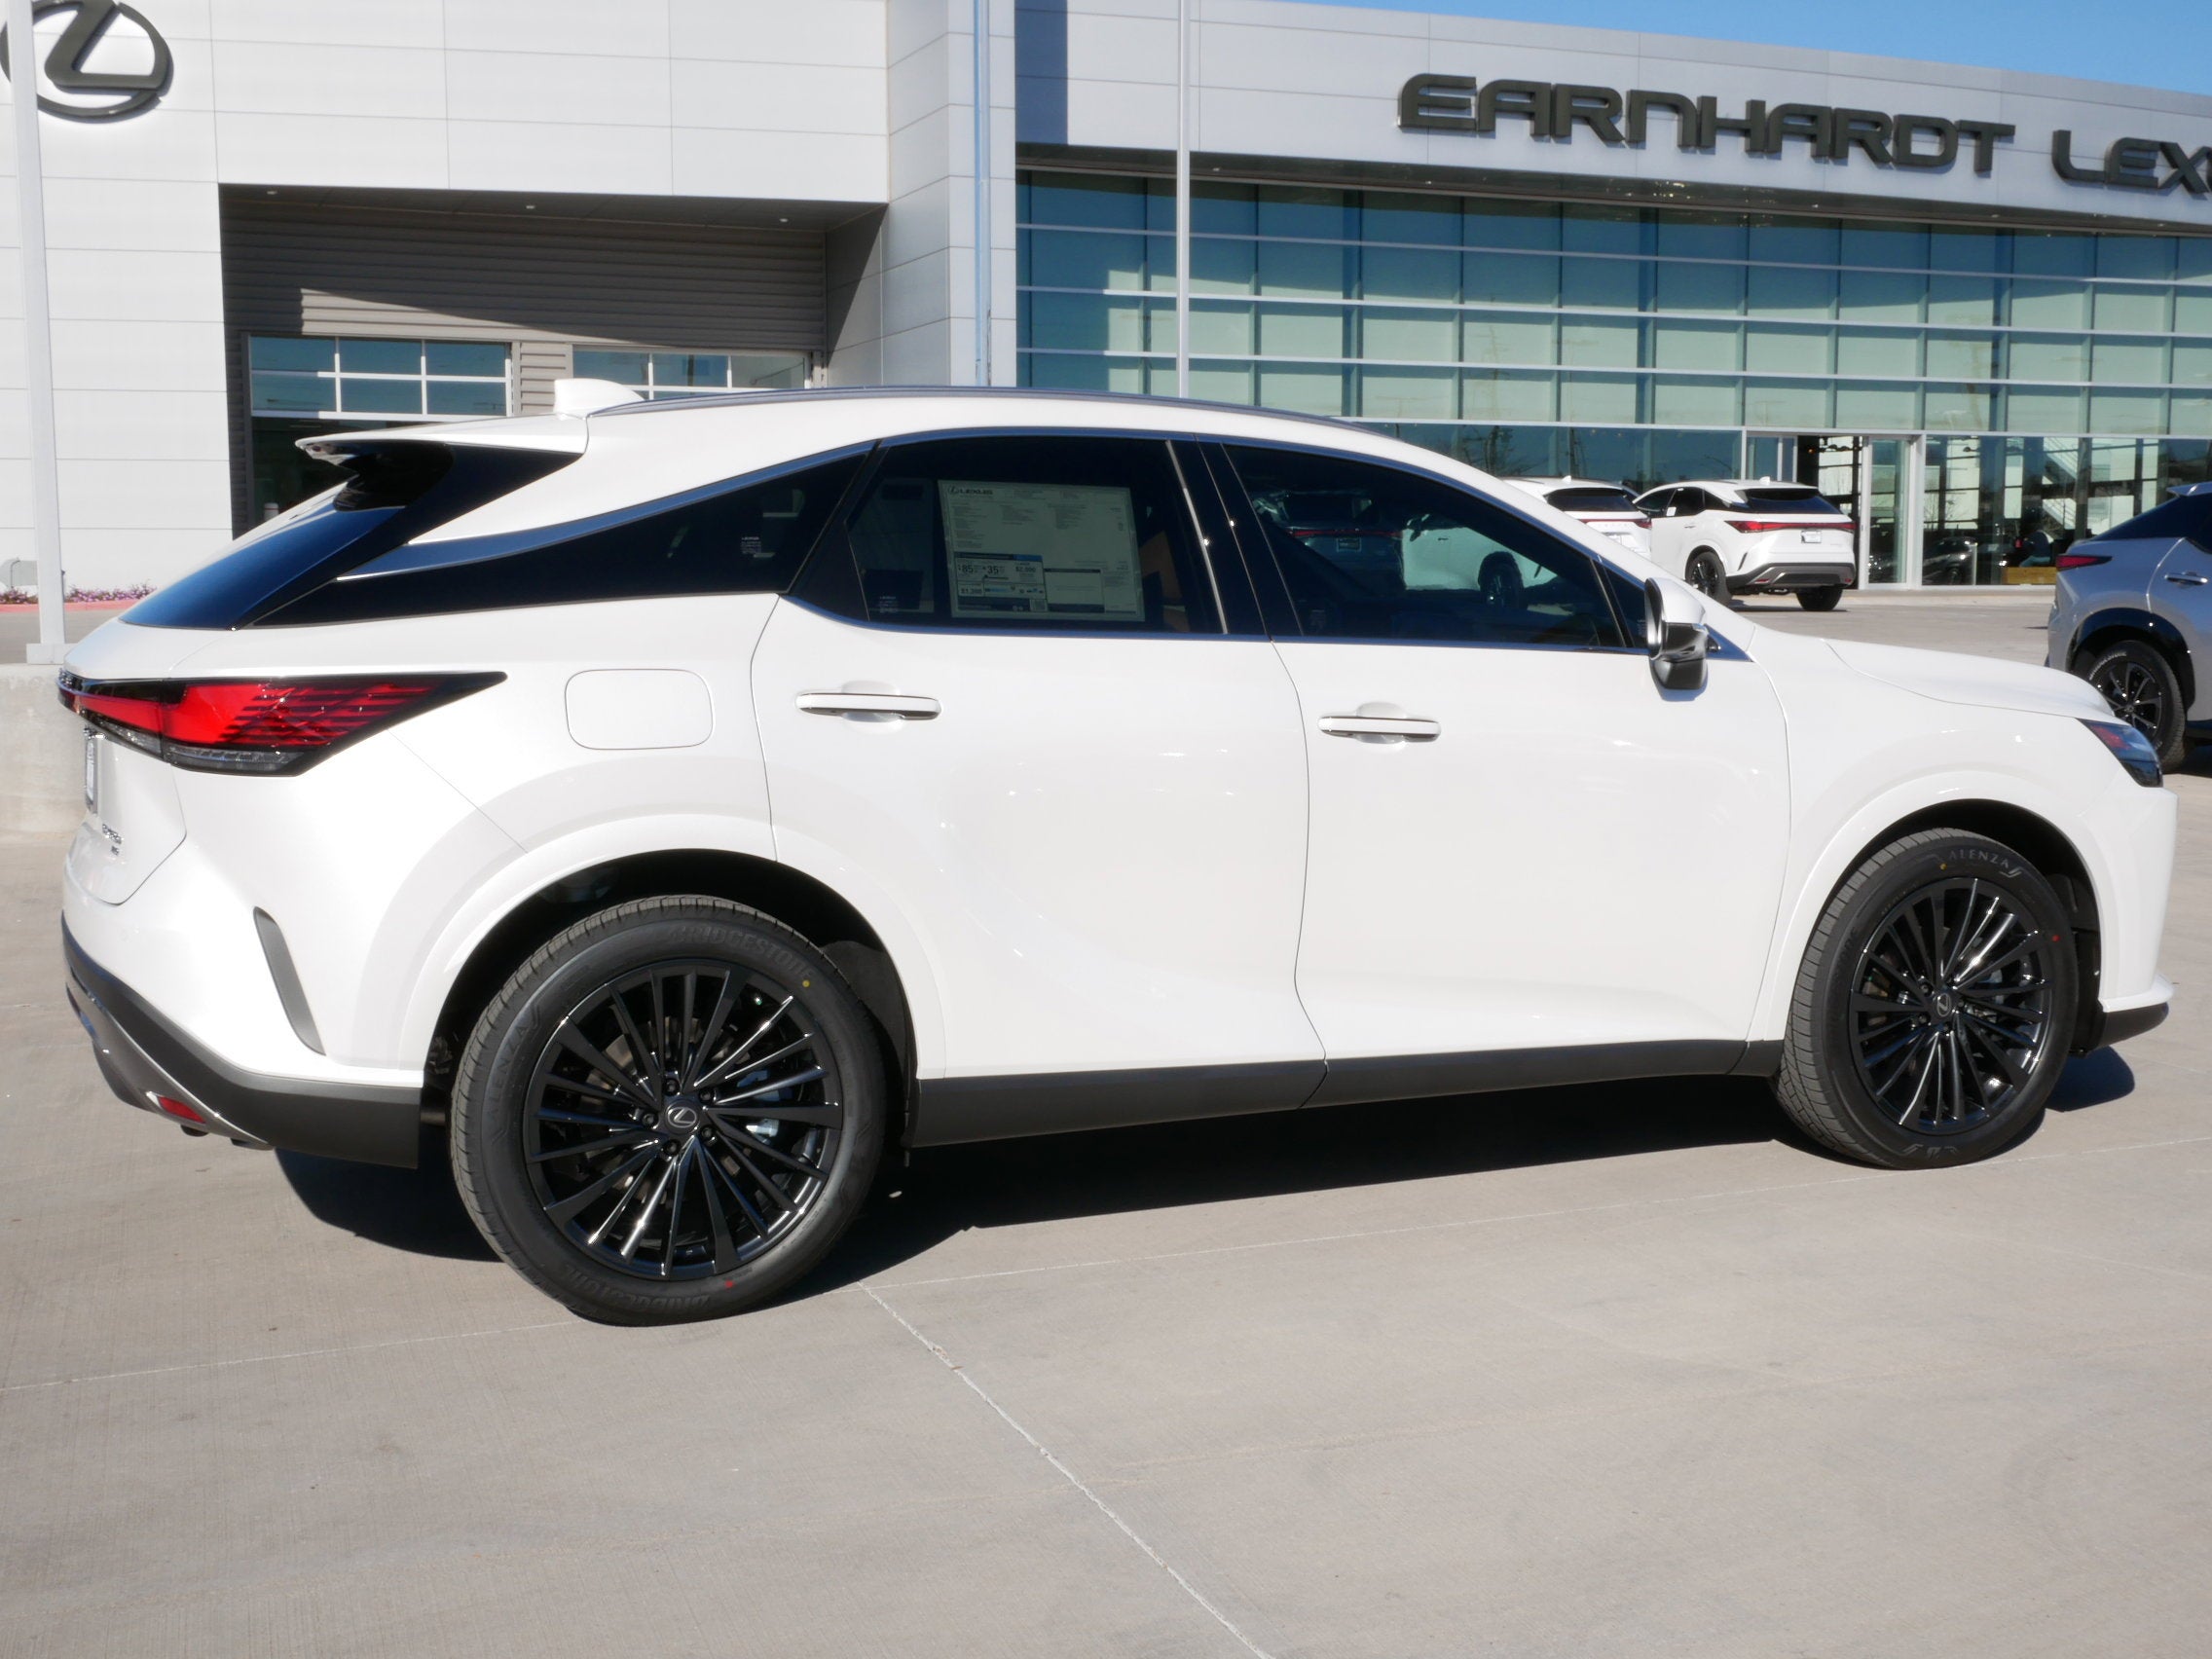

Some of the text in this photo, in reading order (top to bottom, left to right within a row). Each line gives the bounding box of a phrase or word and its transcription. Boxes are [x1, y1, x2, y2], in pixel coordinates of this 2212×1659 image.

[1397, 73, 2212, 194] EARNHARDT LEX
[1949, 848, 2009, 868] ALENZA
[669, 925, 814, 979] BRIDGESTONE
